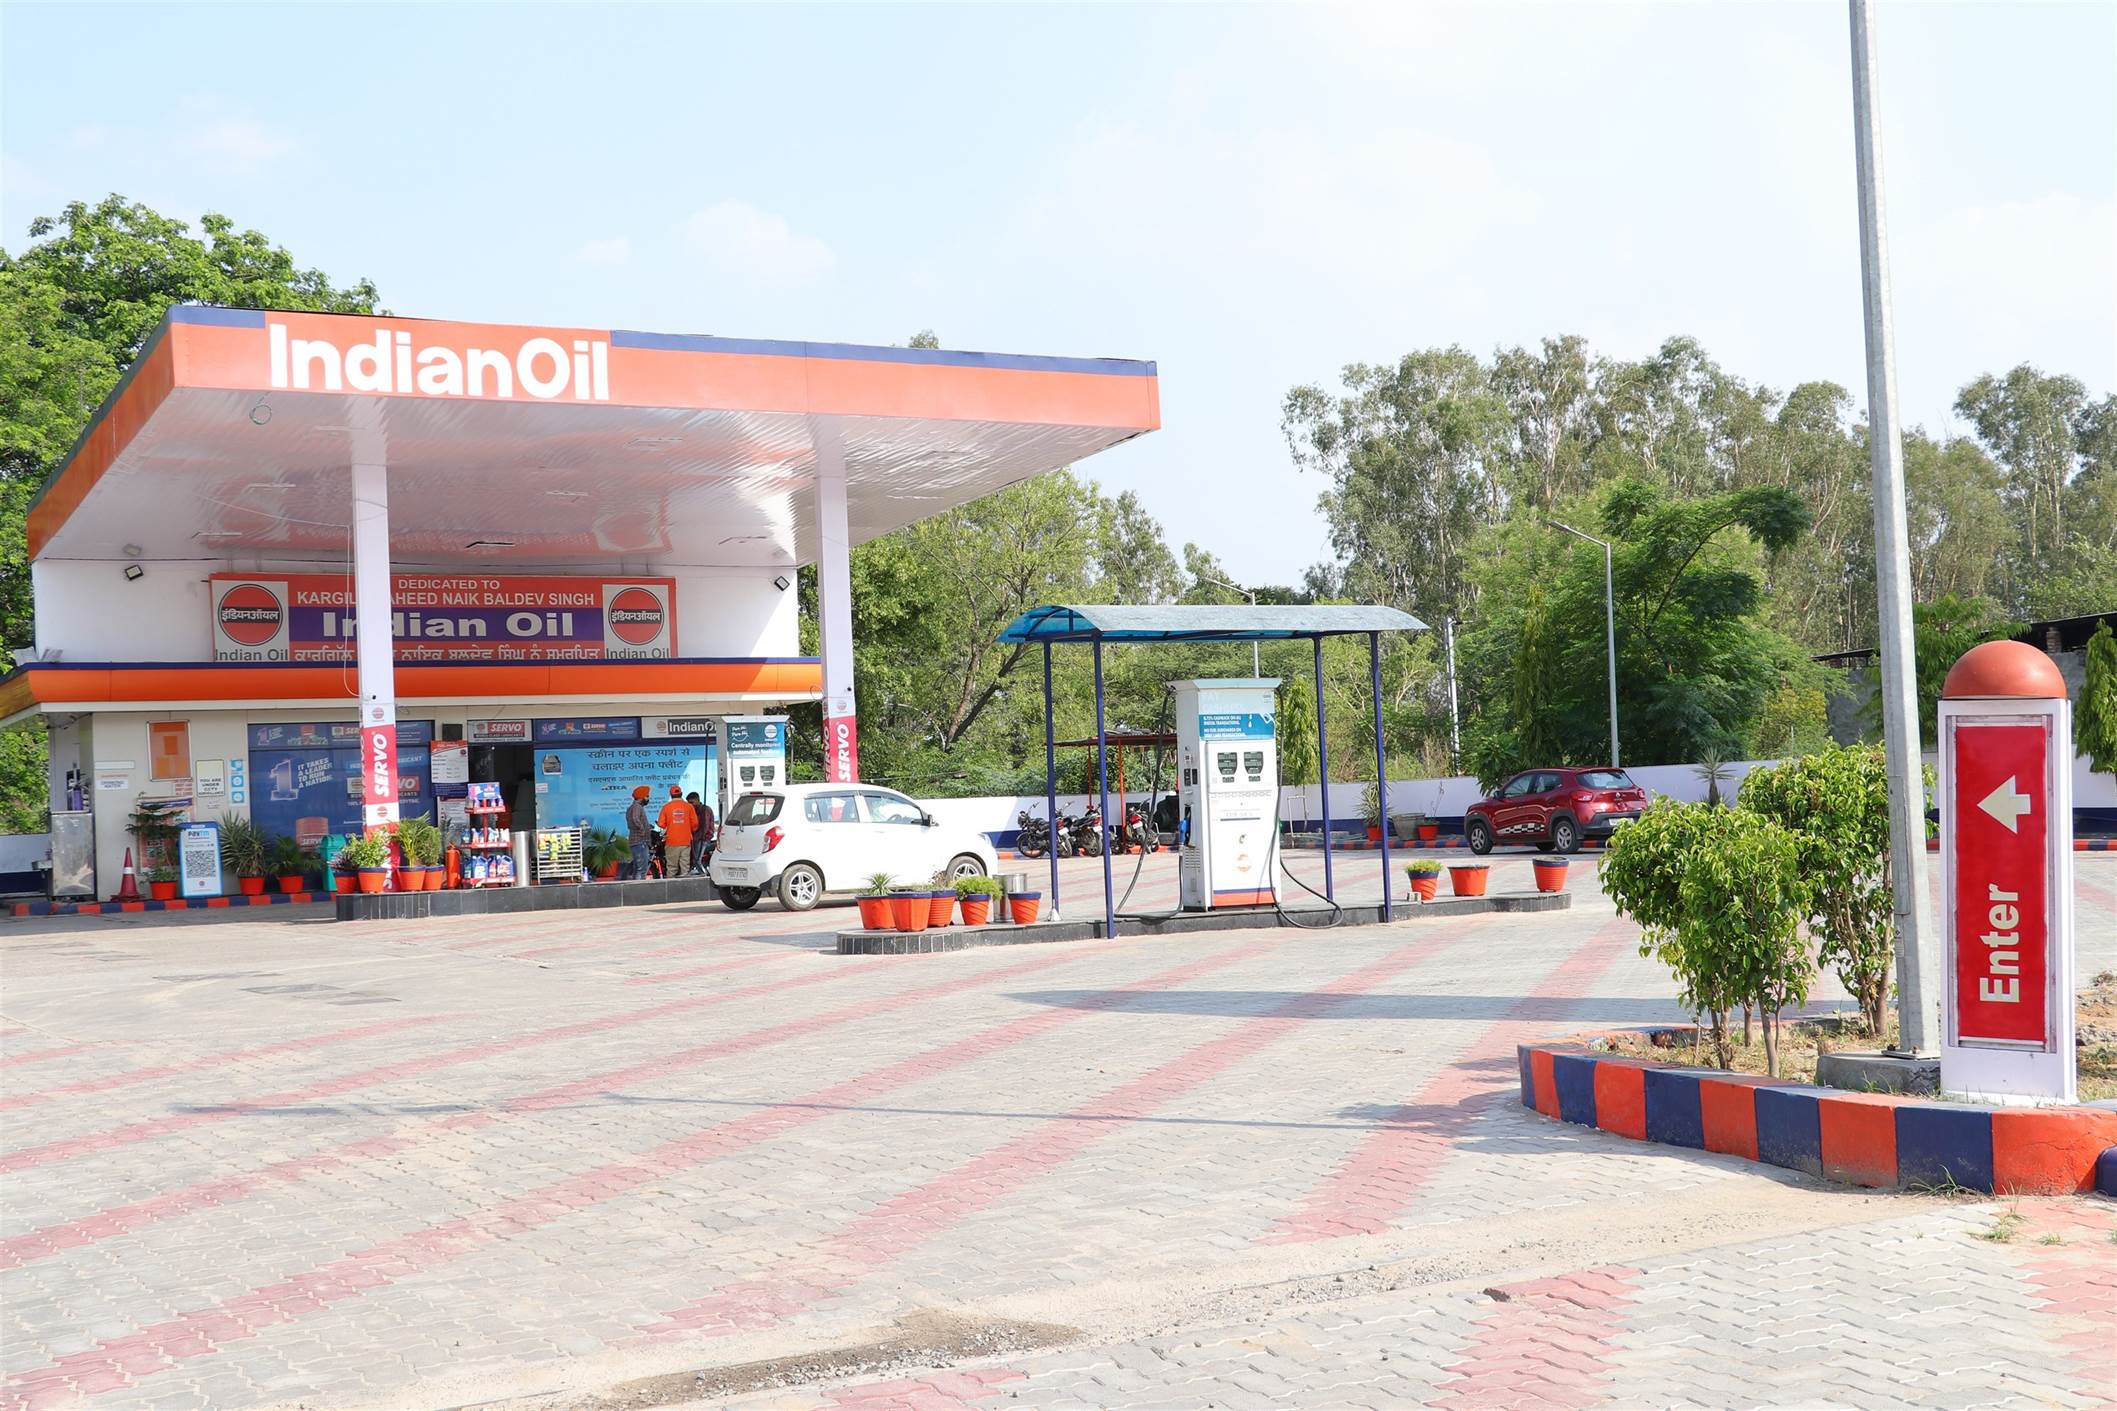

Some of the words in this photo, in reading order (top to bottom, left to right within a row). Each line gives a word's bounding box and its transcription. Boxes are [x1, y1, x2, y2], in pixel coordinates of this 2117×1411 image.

[269, 323, 610, 401] IndianOil
[399, 579, 477, 589] DEDICATED
[482, 580, 500, 589] TO
[297, 592, 356, 605] KARGIL
[391, 592, 438, 605] HEED
[442, 593, 479, 605] NAIK
[484, 593, 544, 605] BALDEV
[549, 594, 594, 606] SINGH
[506, 611, 573, 637] Oil
[215, 648, 265, 661] Indian
[267, 648, 288, 661] Oil
[606, 648, 647, 659] Indian
[651, 648, 670, 659] Oil
[490, 723, 522, 732] SERVO
[669, 721, 716, 732] IndianO
[836, 723, 851, 783] SERVO
[306, 757, 329, 768] TAKES
[372, 732, 391, 798] SERVO
[1979, 883, 2020, 1003] Enter
